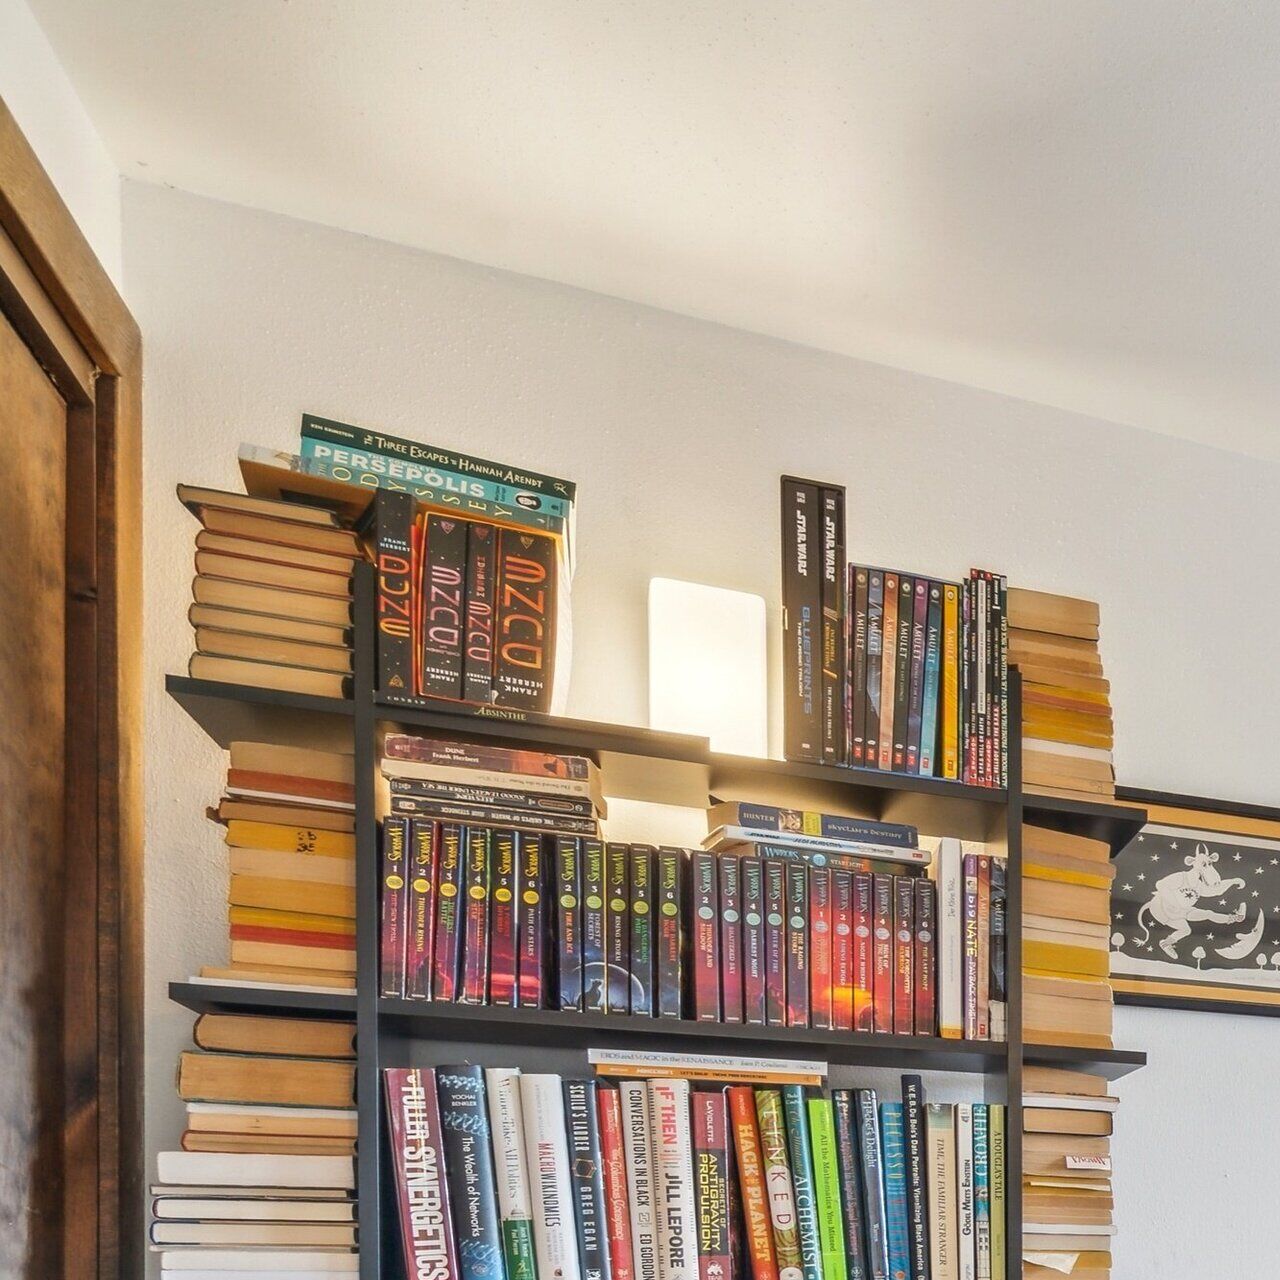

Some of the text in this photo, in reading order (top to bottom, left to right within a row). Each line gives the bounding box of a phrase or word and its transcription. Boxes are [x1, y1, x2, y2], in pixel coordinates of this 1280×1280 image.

[315, 445, 485, 498] PERSEPOLIS
[374, 436, 407, 454] THREE
[410, 444, 448, 465] ESCAPES
[459, 459, 502, 478] HANNAH
[504, 471, 543, 488] ARENDT
[333, 466, 512, 518] ODYSSEY
[797, 510, 807, 576] STAR WARS
[825, 516, 835, 581] STAR WARS
[856, 611, 864, 650] AMULET
[913, 622, 921, 660] AMULET
[802, 606, 812, 714] BLUEPRINTS
[474, 707, 527, 721] ABSINTHE
[416, 831, 430, 864] WARRIORS
[525, 844, 539, 877] WARRIORS
[528, 925, 534, 934] OF
[614, 939, 622, 961] STORM
[966, 920, 977, 957] NATE
[401, 1087, 429, 1139] FULLER
[661, 1105, 678, 1144] THEN
[629, 1089, 650, 1207] CONVERSATIONS IN BLACK
[763, 1109, 791, 1225] LINKED
[462, 1136, 481, 1237] The Wealth of Networks
[538, 1142, 561, 1227] MACROWIKINOMICS
[700, 1154, 711, 1250] PROPULSION
[709, 1154, 721, 1251] ANTIGRAVITY
[738, 1124, 771, 1261] HACK PLANET
[579, 1187, 595, 1251] GREG EGAN
[640, 1234, 652, 1245] ED
[666, 1208, 684, 1268] LEPORE
[794, 1173, 815, 1269] ALCHEMIST
